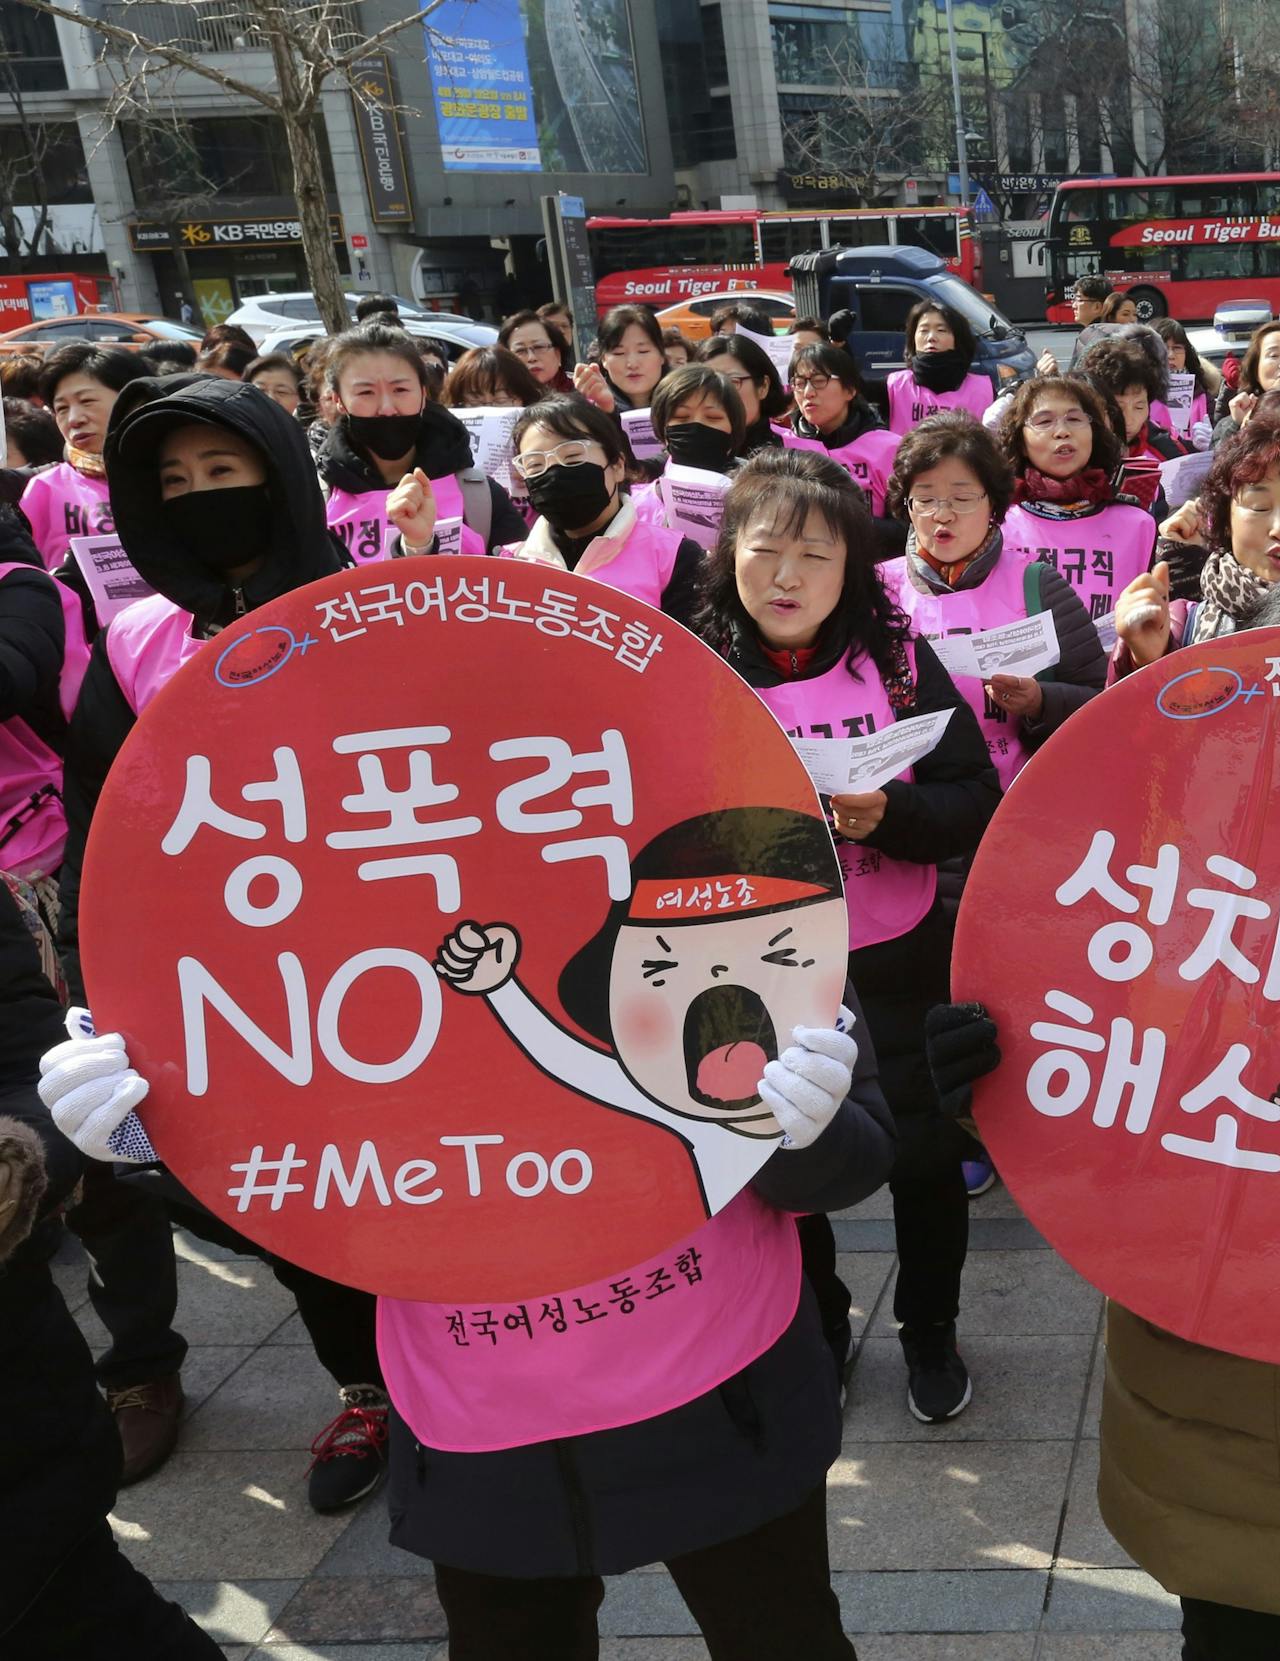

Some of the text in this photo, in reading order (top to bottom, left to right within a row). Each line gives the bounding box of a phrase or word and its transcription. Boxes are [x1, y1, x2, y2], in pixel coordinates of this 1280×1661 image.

[213, 221, 302, 242] KB국민은행
[1141, 225, 1194, 243] Seoul
[1203, 223, 1251, 243] Tiger
[625, 280, 671, 296] Seoul
[677, 279, 719, 297] Tiger
[315, 576, 664, 674] 전국여성노동조합
[161, 725, 634, 927] 성폭력
[654, 877, 759, 912] 여성노조
[177, 947, 443, 1097] NO
[230, 1134, 594, 1212] #MeToo
[445, 1247, 703, 1346] 전국여성노동조합
